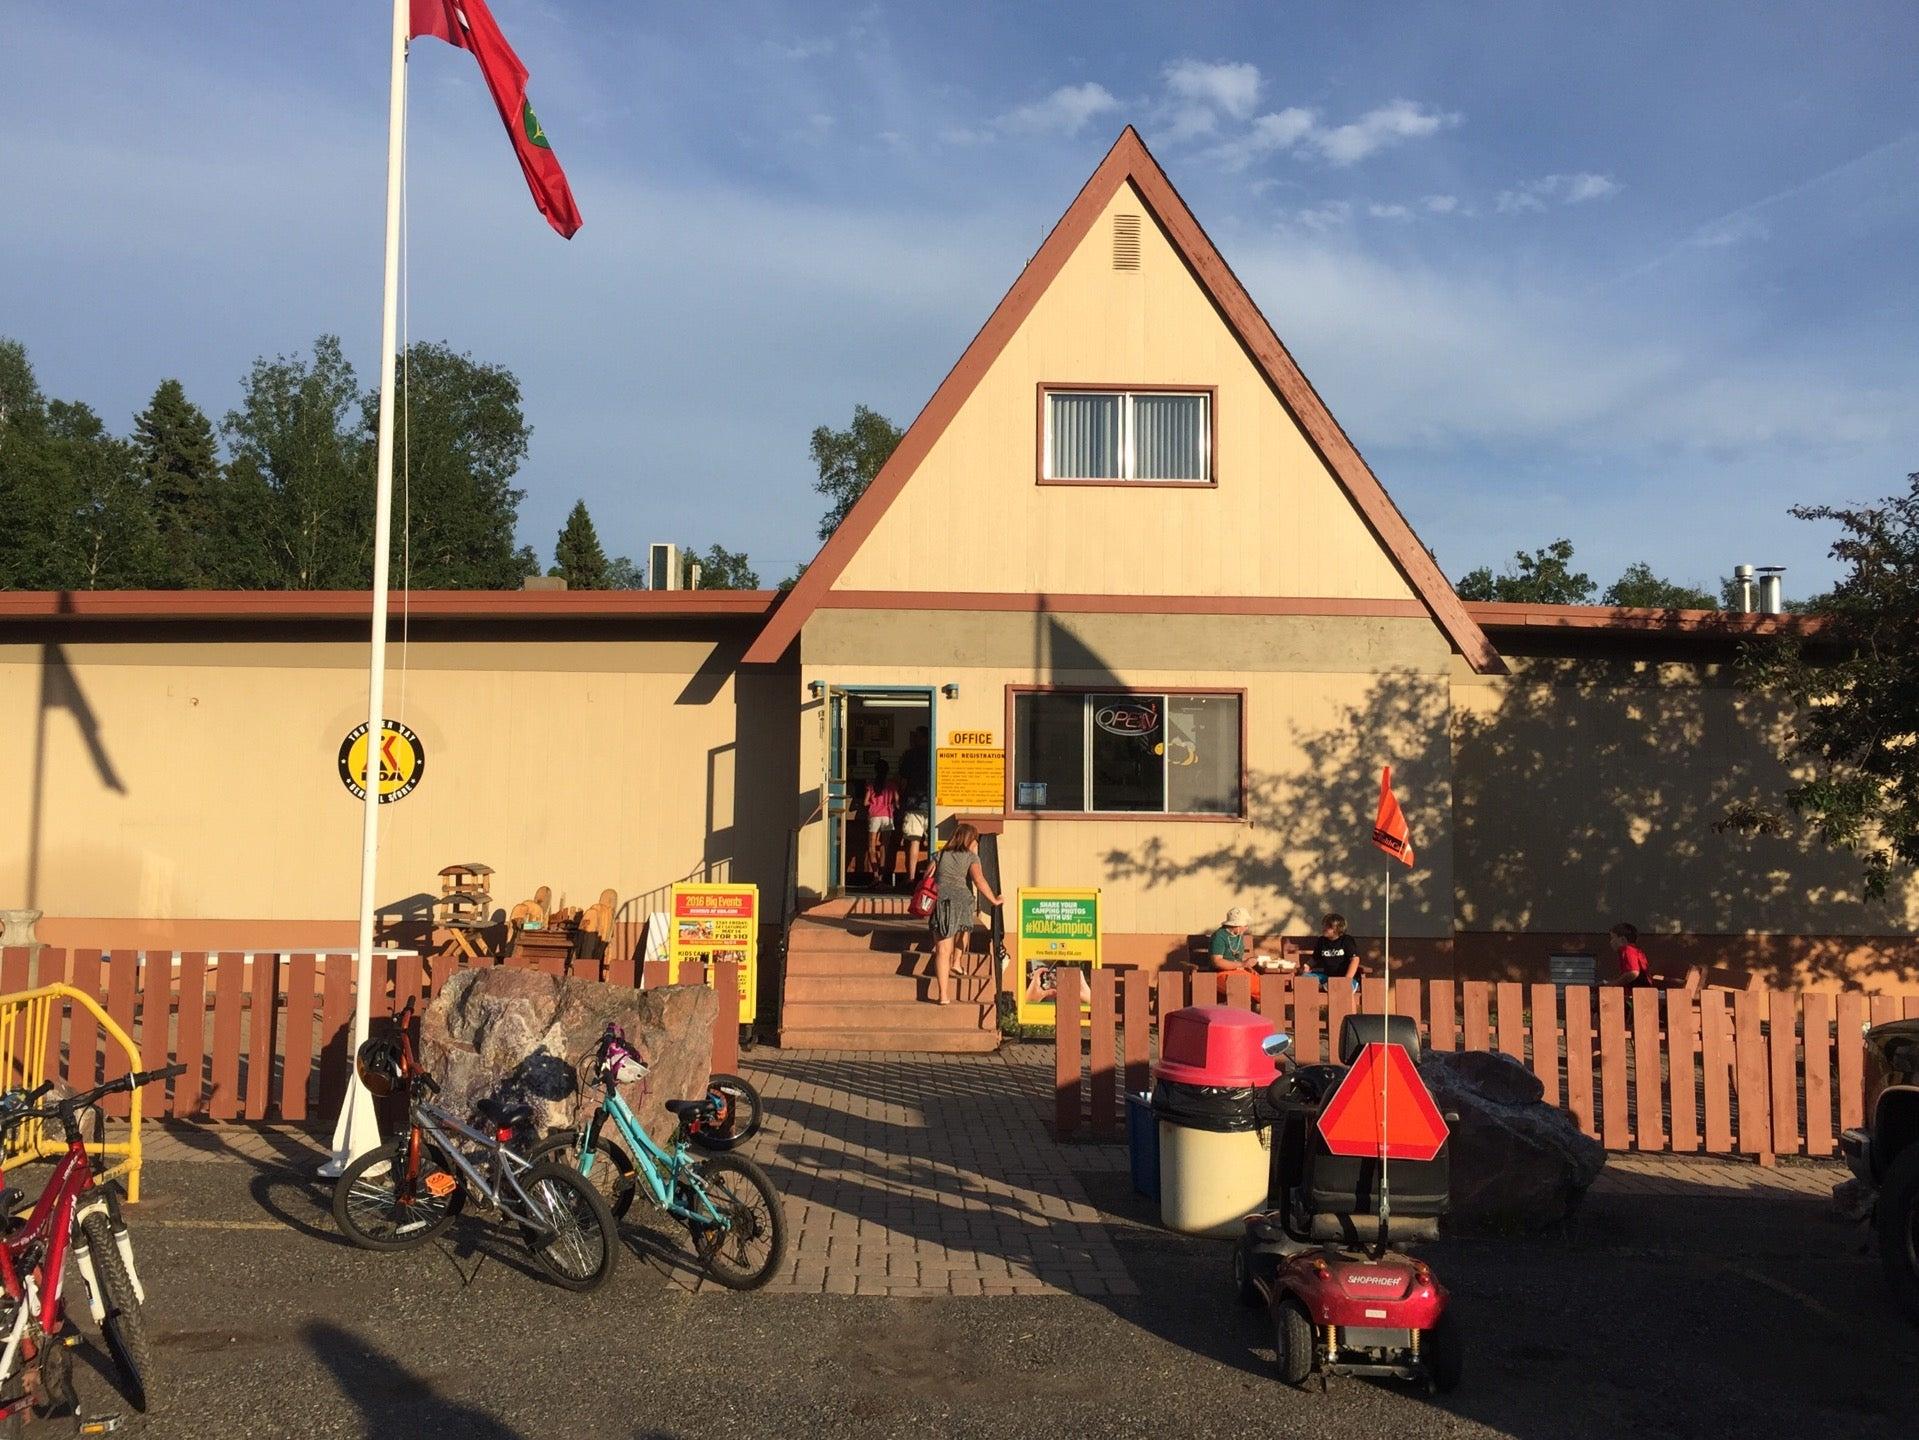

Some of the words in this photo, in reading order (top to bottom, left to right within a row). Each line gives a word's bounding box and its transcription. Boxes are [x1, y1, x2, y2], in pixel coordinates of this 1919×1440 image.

[1098, 709, 1158, 730] OPEN
[954, 733, 992, 744] OFFICE
[388, 784, 413, 803] STORE
[686, 896, 704, 906] 2016
[706, 896, 718, 908] Big
[718, 896, 742, 906] Events
[1026, 920, 1092, 937] #KOACamping
[1348, 1275, 1401, 1286] SHOPRIDER
